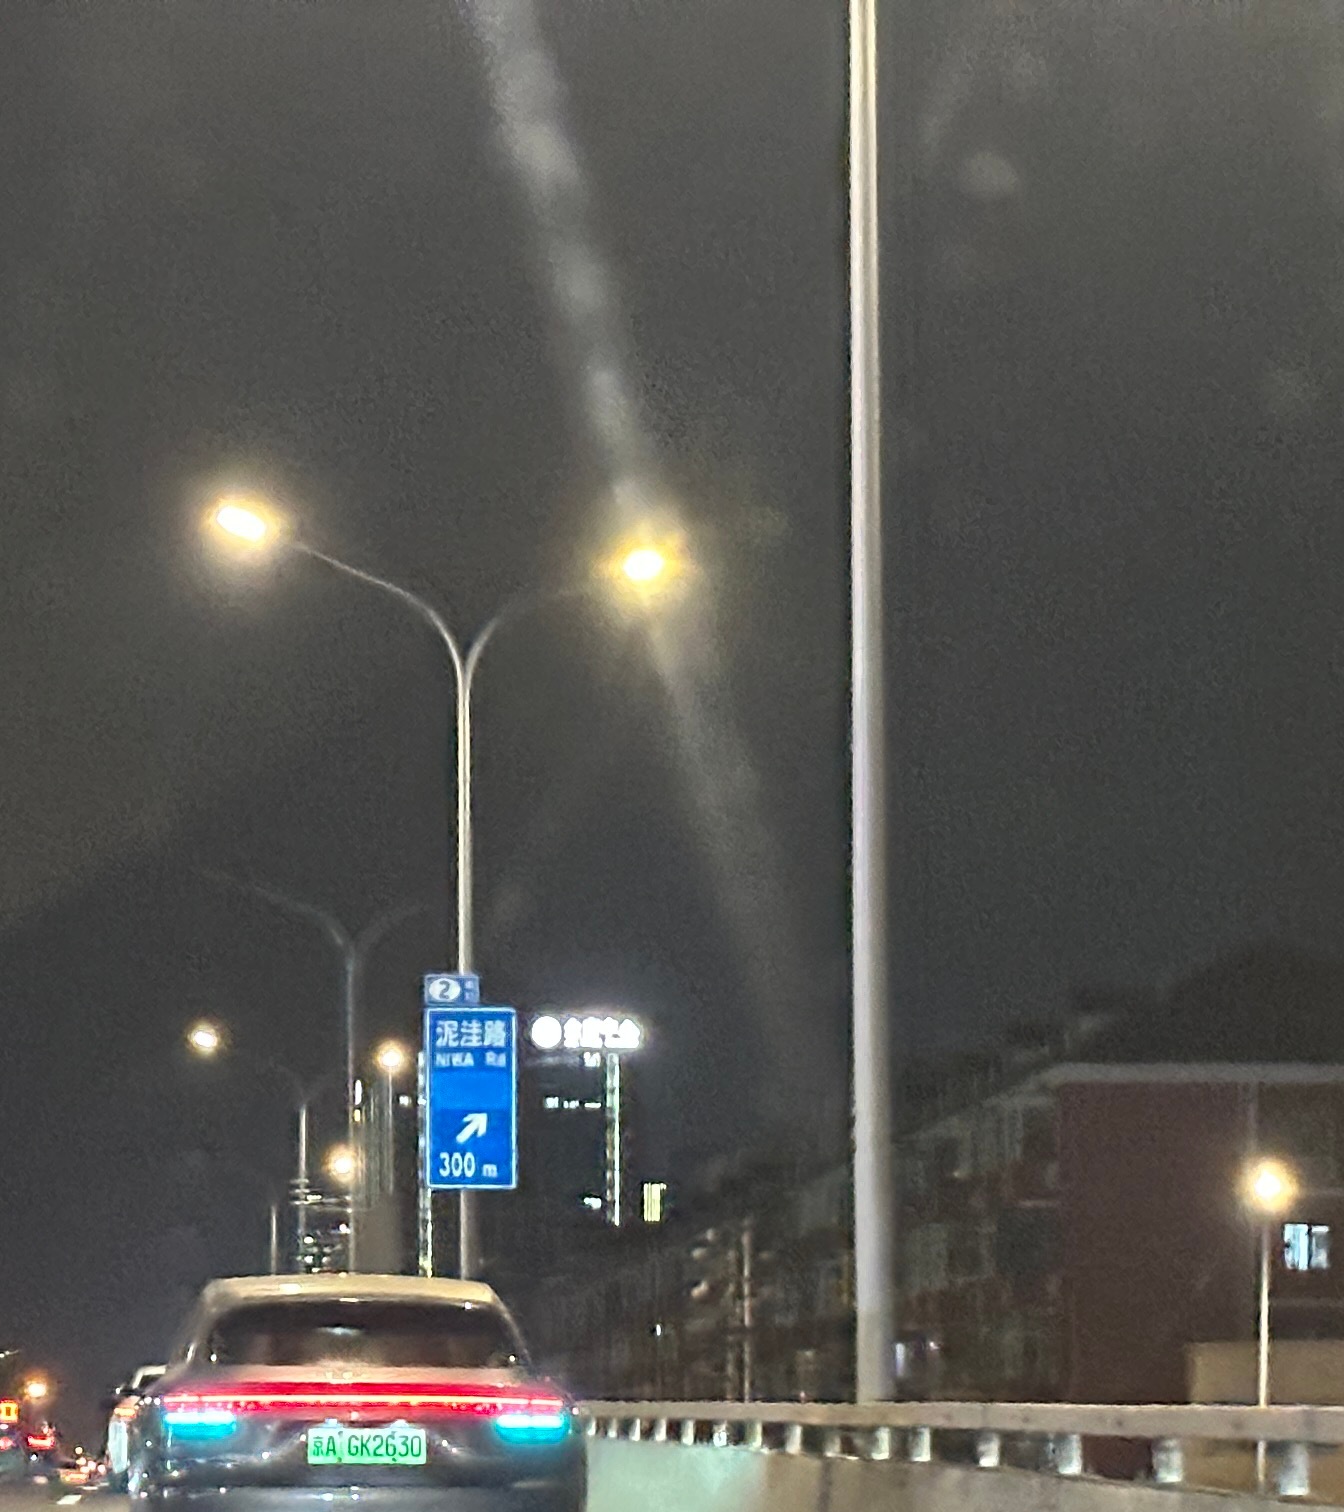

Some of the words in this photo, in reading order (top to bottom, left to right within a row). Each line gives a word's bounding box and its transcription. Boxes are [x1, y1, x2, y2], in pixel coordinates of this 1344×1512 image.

[438, 980, 450, 1000] 2
[436, 1020, 506, 1047] 泥洼路
[439, 1152, 475, 1177] 300
[483, 1164, 497, 1178] m
